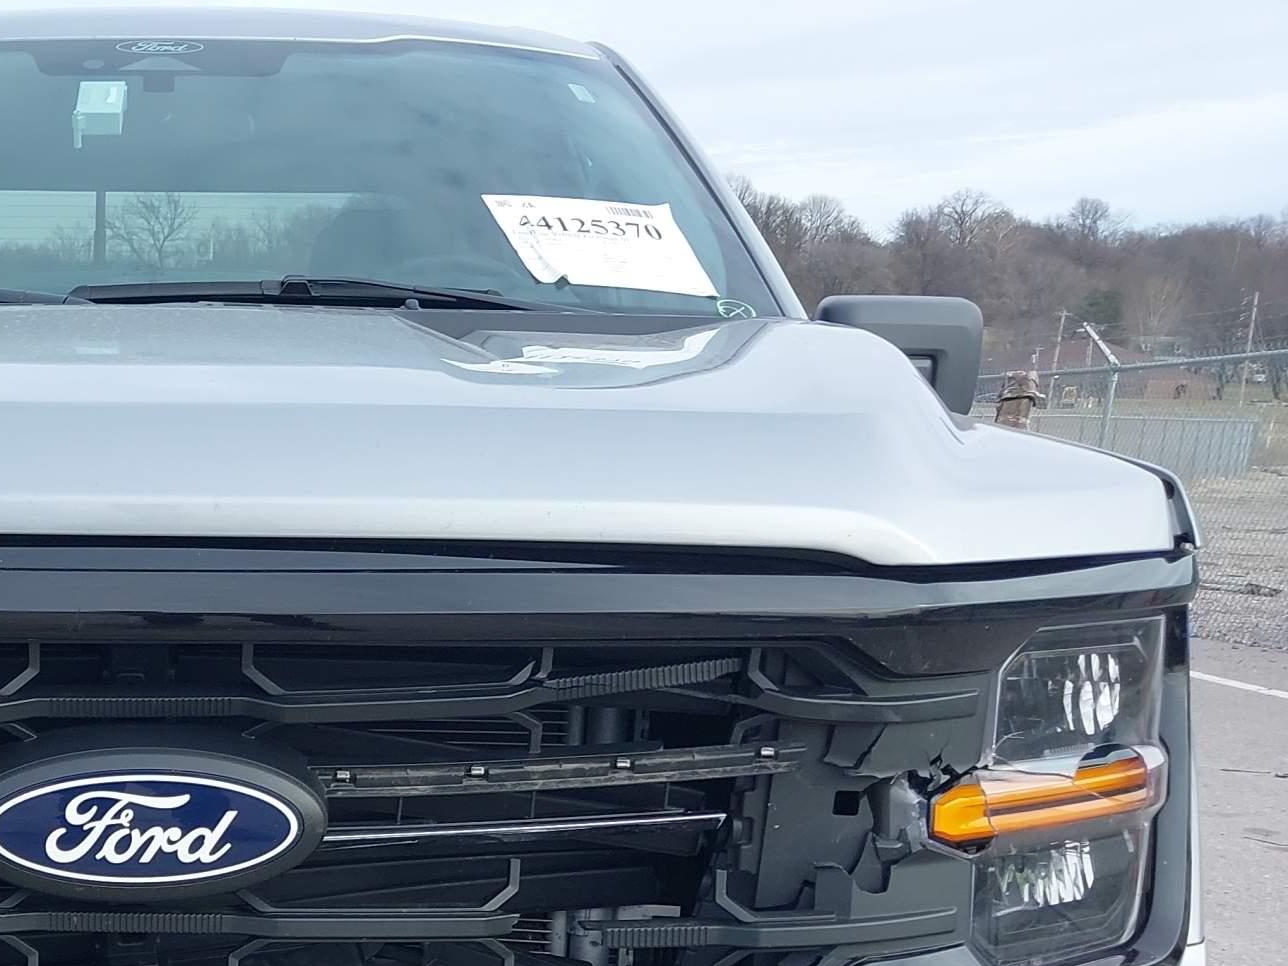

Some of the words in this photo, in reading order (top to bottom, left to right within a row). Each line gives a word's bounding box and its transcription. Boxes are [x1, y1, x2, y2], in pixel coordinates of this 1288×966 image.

[131, 40, 190, 52] Ford
[519, 214, 663, 241] 44125370
[45, 790, 239, 864] Ford
